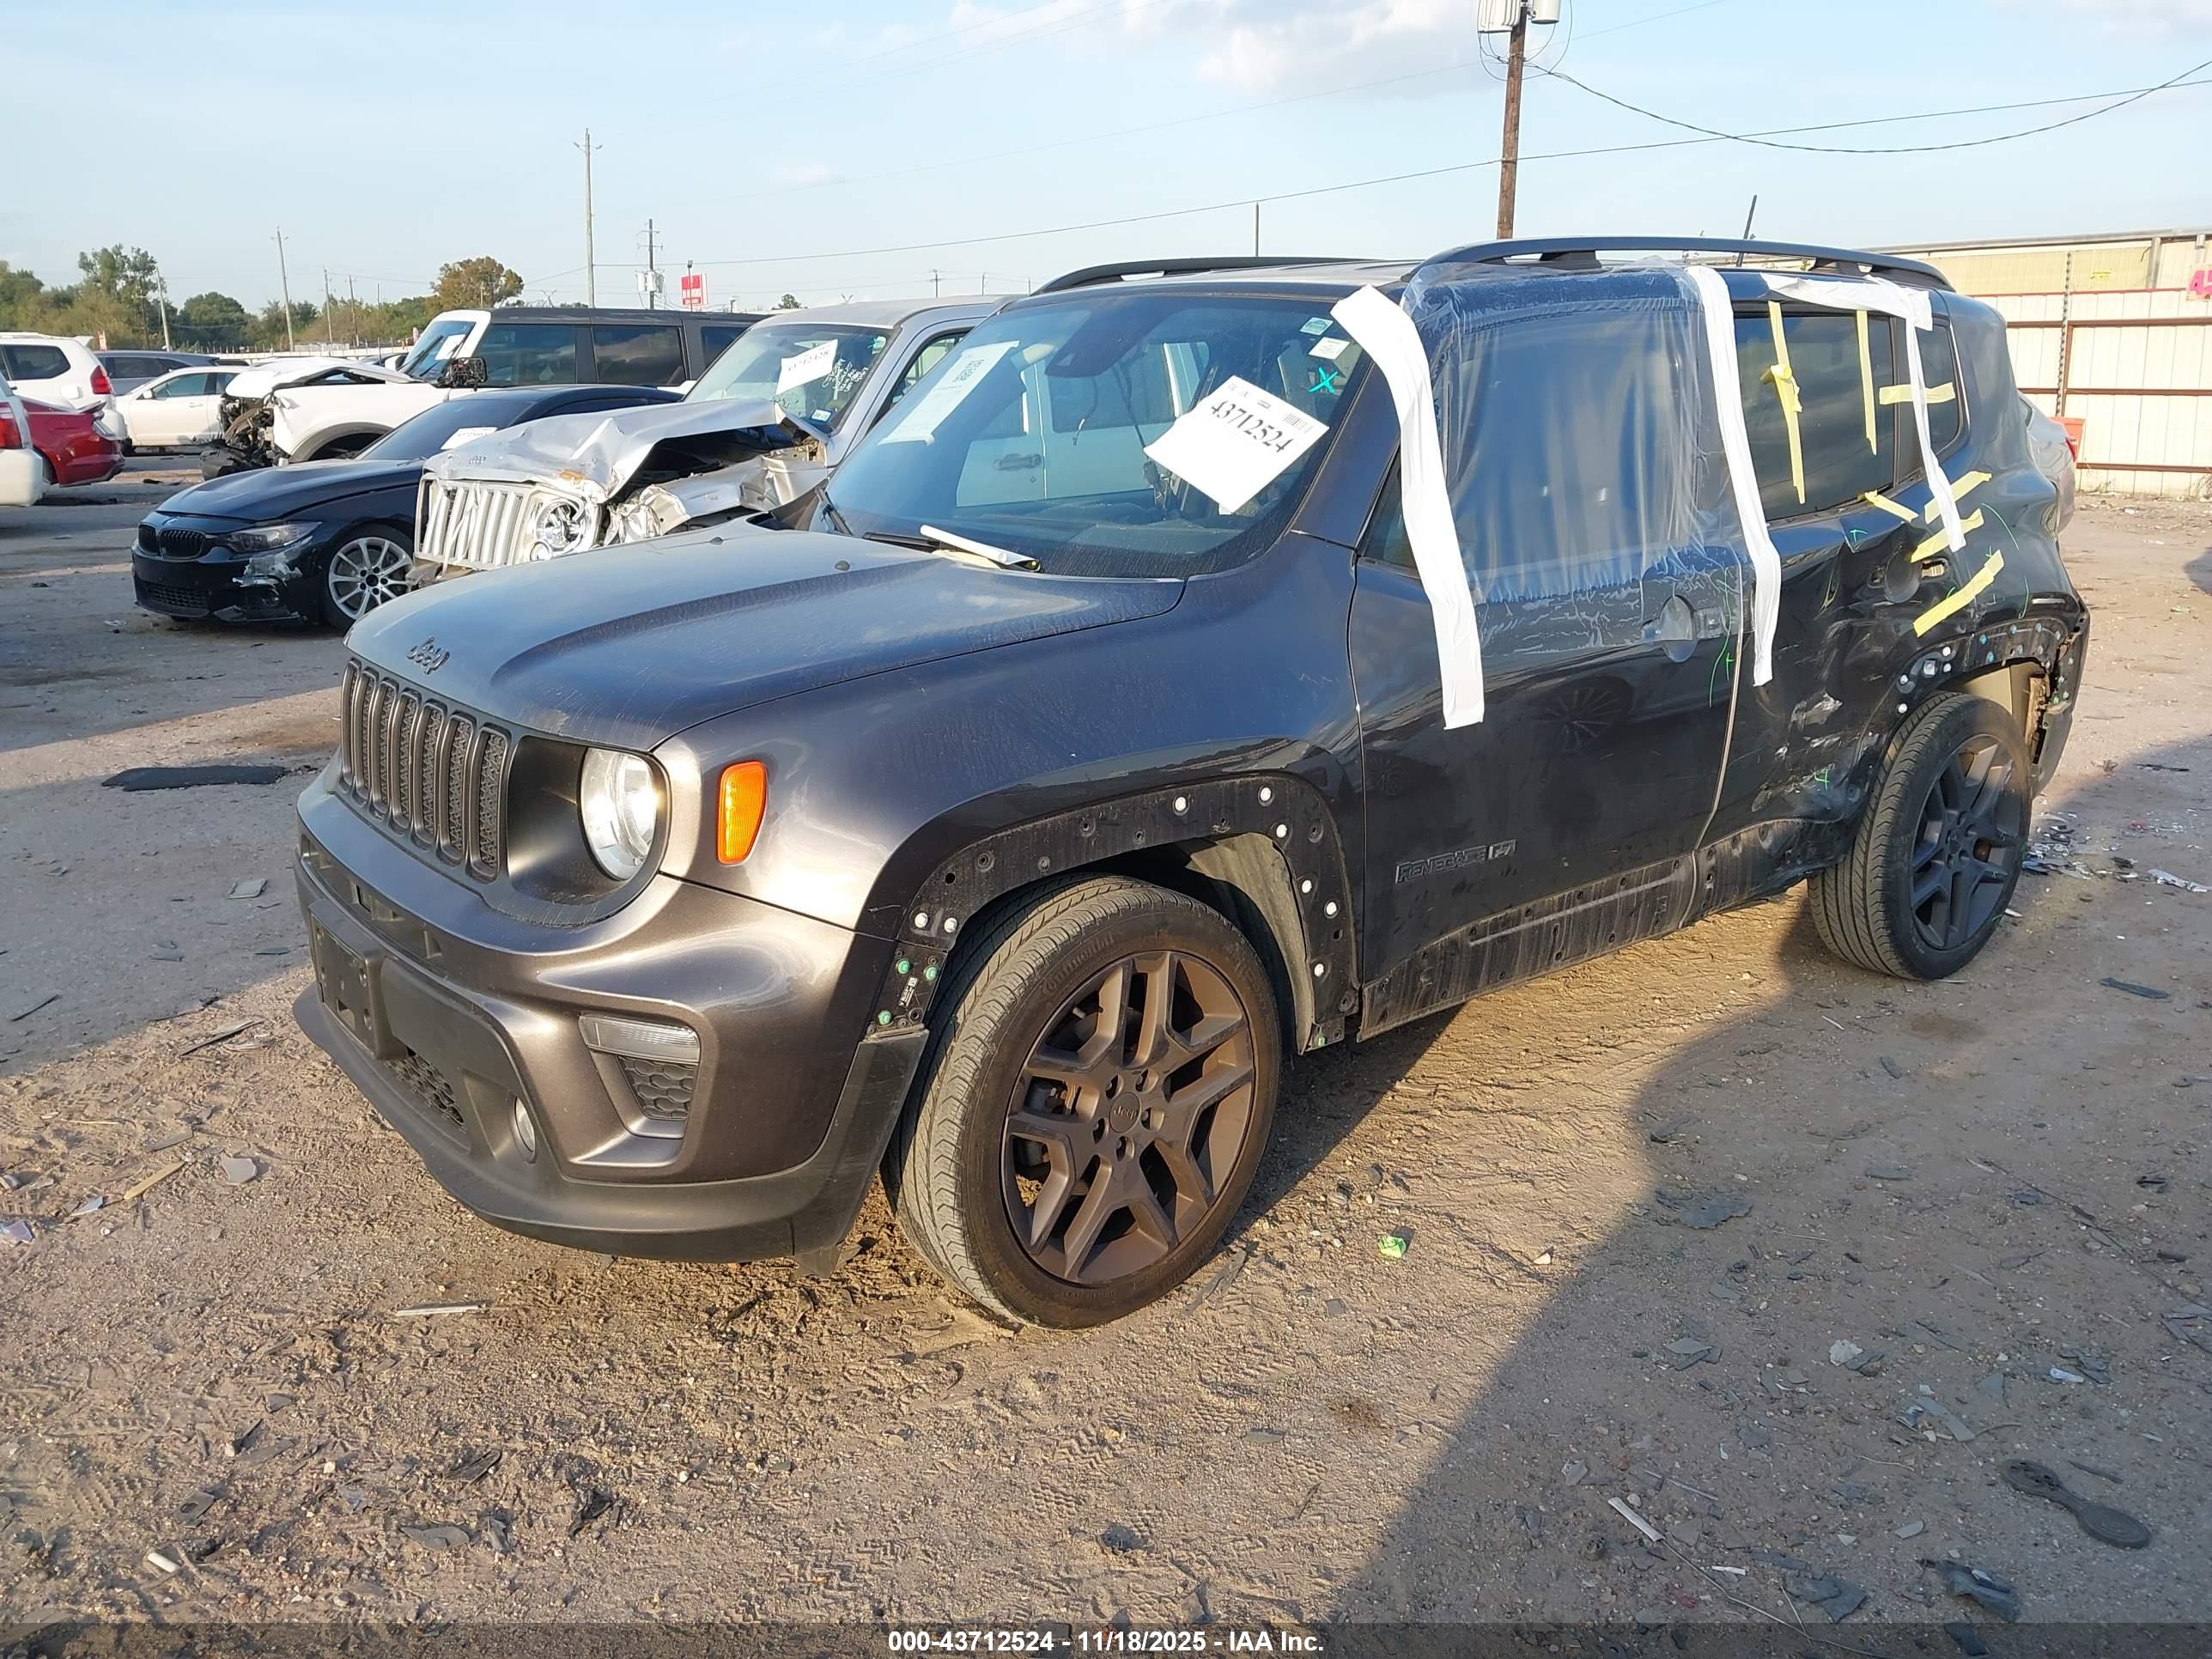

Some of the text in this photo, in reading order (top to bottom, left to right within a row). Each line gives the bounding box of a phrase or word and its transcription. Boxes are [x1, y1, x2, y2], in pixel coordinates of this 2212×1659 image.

[1211, 399, 1295, 453] 43712524
[405, 635, 451, 676] Jeep
[1395, 844, 1487, 885] RENEGADE
[1113, 1105, 1138, 1121] Jeep
